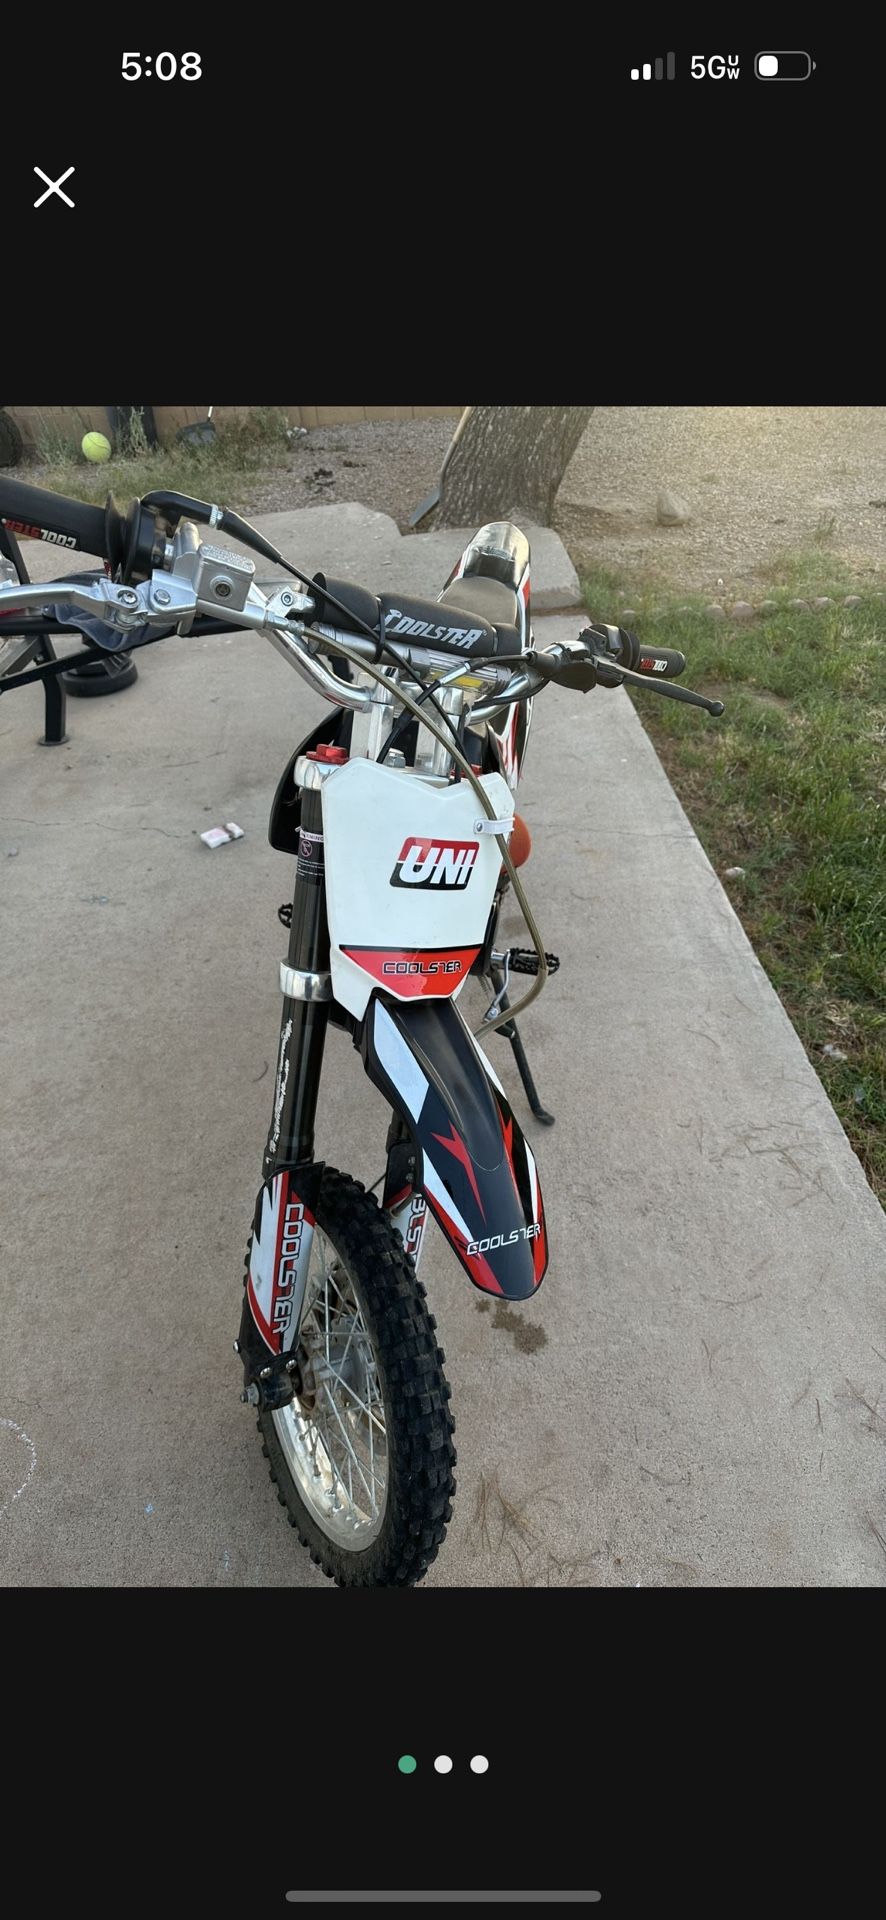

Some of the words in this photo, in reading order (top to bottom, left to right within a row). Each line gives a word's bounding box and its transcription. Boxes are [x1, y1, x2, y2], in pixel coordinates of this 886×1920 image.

[373, 608, 483, 650] COOLSTER
[398, 844, 477, 885] UNI
[382, 960, 462, 975] COOLSTER
[466, 1222, 542, 1256] COOLSTER
[272, 1203, 306, 1335] COOLSTER
